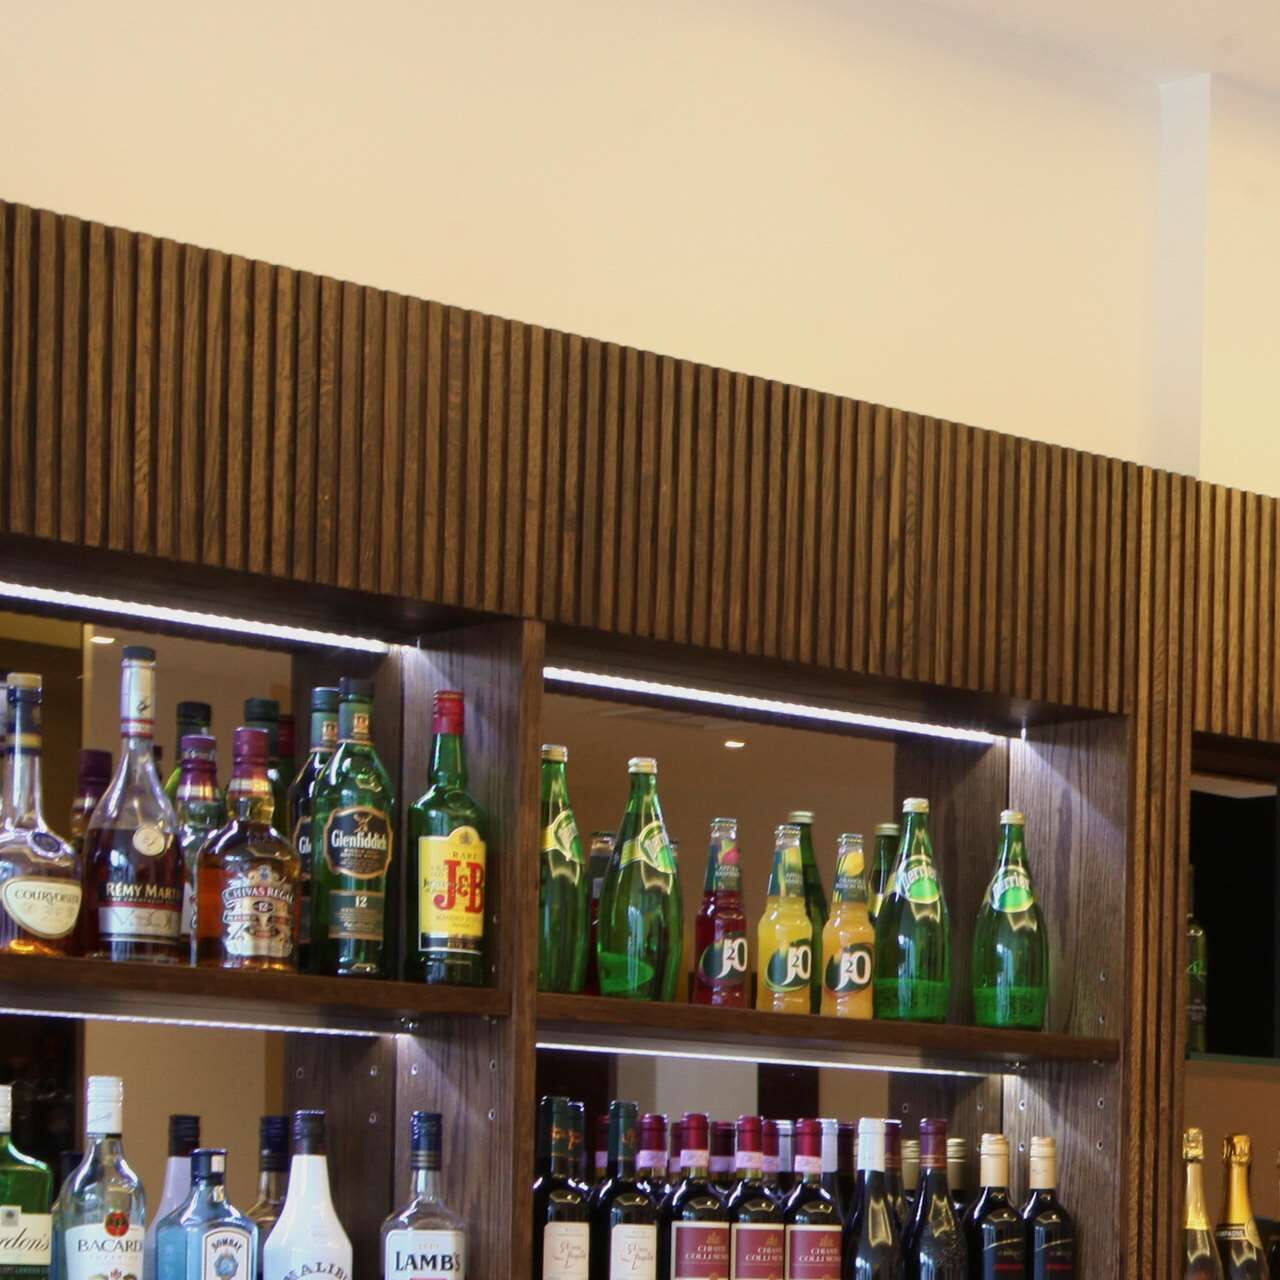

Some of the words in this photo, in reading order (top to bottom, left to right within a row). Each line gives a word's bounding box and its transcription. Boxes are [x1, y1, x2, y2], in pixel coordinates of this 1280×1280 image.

[433, 859, 485, 914] J&B
[354, 895, 369, 908] 12
[77, 1239, 143, 1253] BACARD
[395, 1250, 462, 1273] LAMB'S
